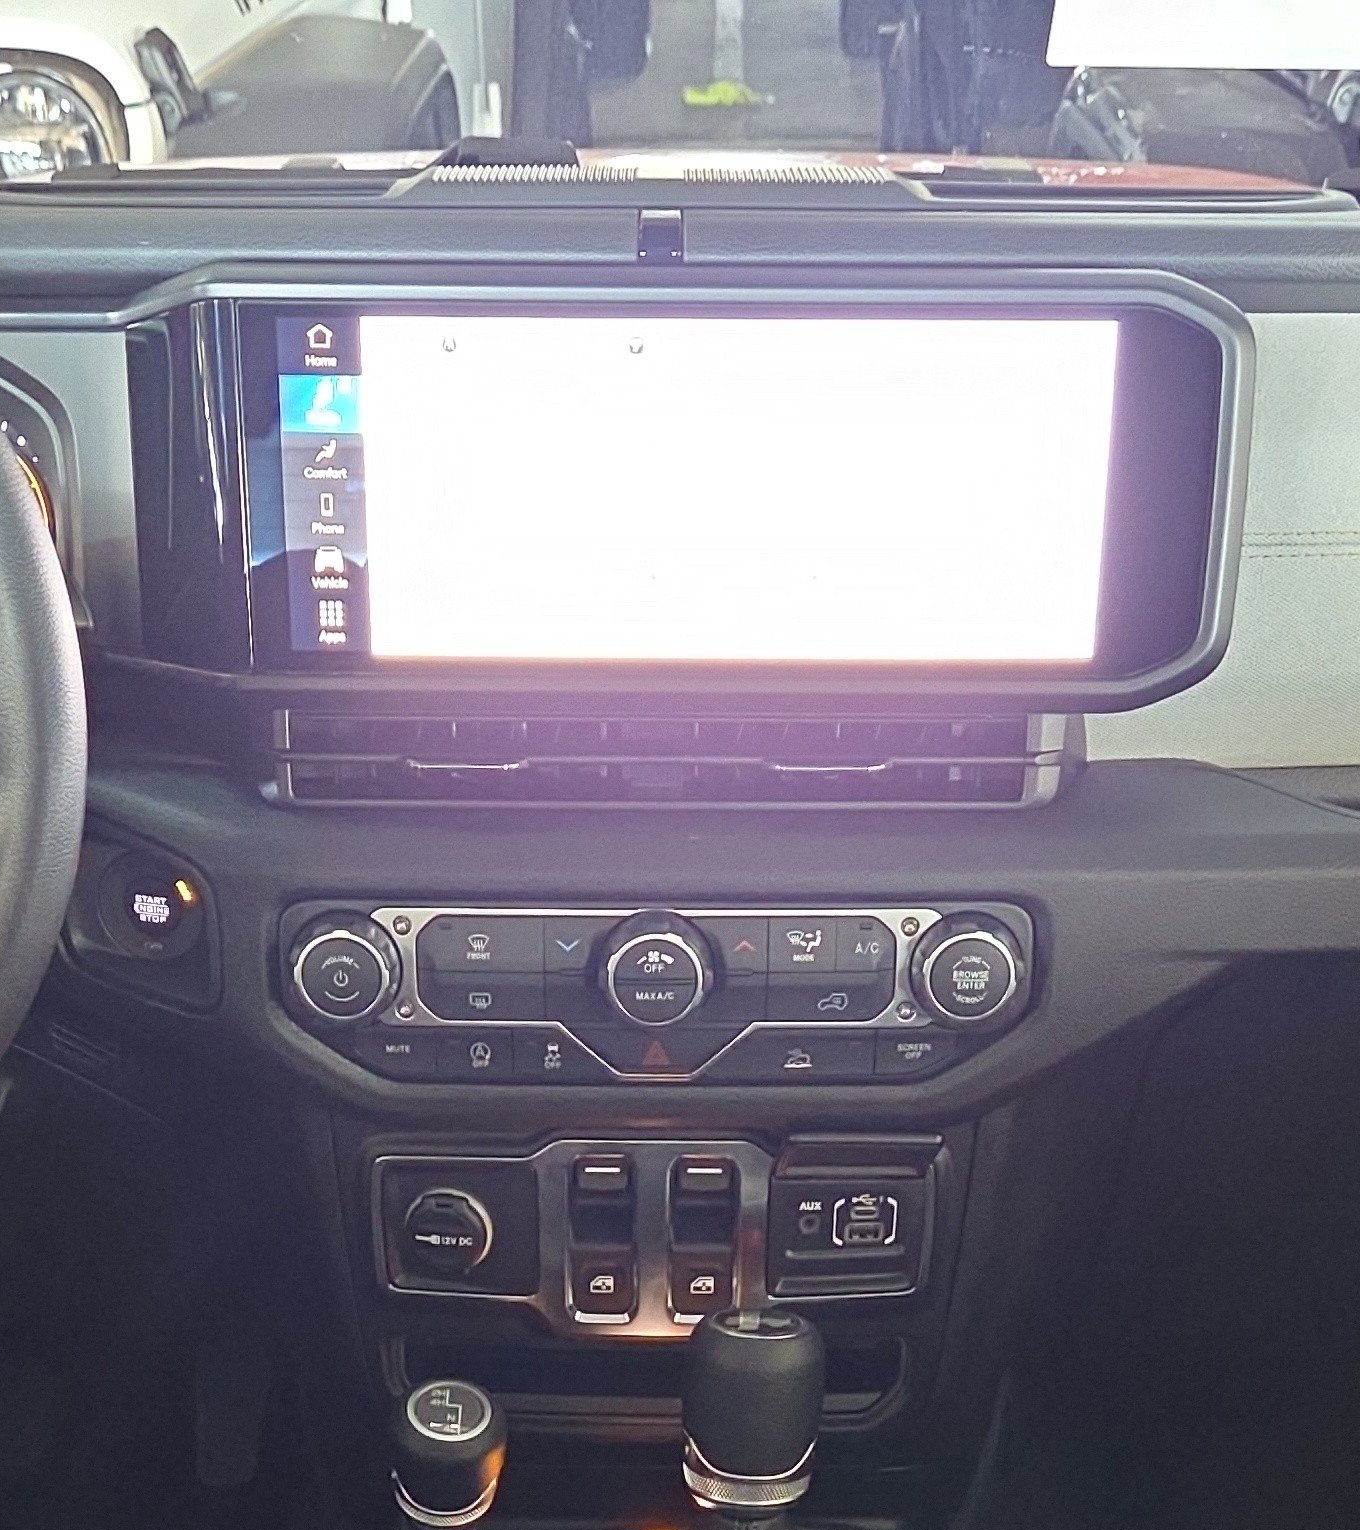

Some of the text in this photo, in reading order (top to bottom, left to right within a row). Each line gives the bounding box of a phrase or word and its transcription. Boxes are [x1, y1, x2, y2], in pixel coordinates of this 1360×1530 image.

[304, 355, 338, 368] Home
[303, 466, 348, 481] Comfort
[311, 522, 345, 535] Phone
[311, 576, 349, 590] Vehicle
[318, 630, 347, 645] Apps
[135, 894, 168, 906] START
[134, 903, 171, 917] ENGINE
[139, 914, 167, 924] STOP
[854, 942, 879, 954] A/C
[466, 952, 491, 960] FRONT
[792, 953, 815, 962] MODE
[643, 963, 666, 973] OFF
[952, 970, 989, 981] BROWSE
[956, 981, 986, 990] ENTER
[635, 991, 675, 1001] MAX A/C
[385, 1044, 411, 1054] MUTE
[896, 1043, 932, 1052] SCREEN
[904, 1051, 922, 1060] OFF
[798, 1201, 823, 1211] AUX
[441, 1236, 474, 1247] 12V DC
